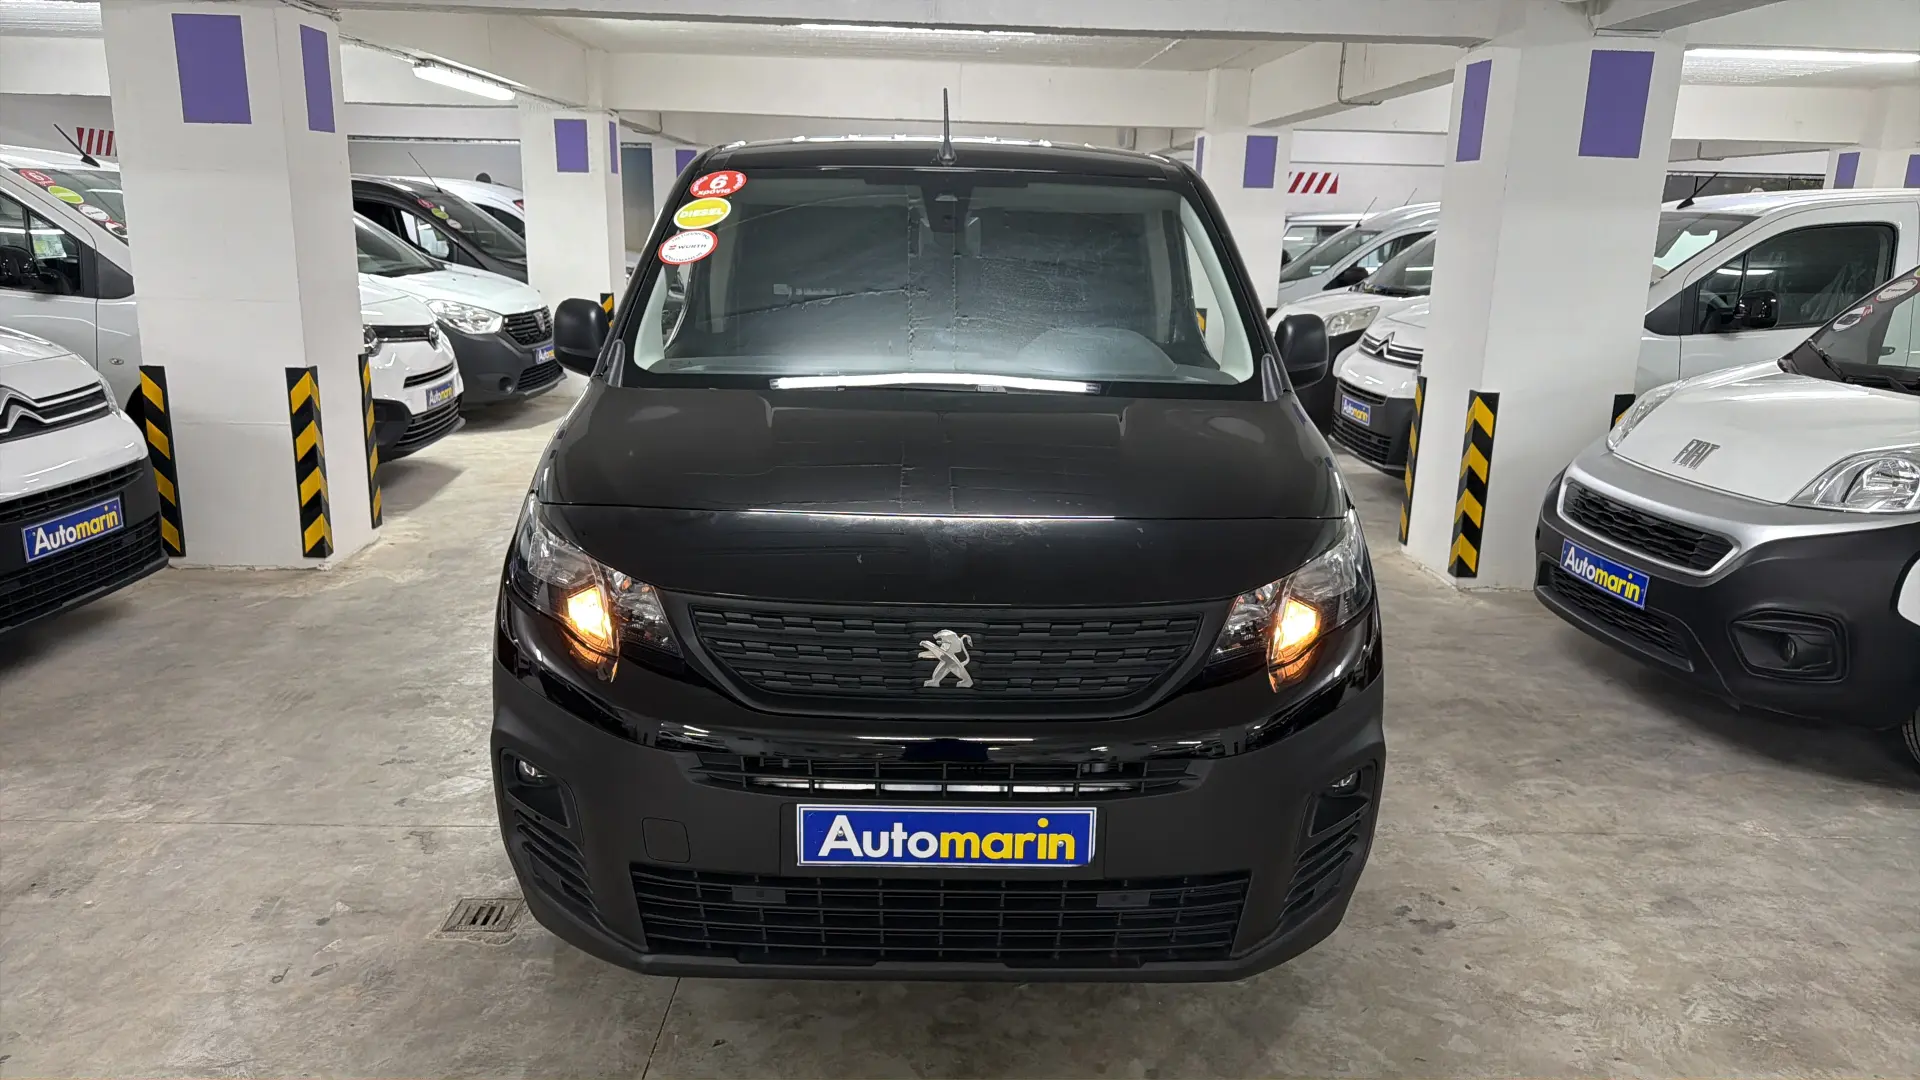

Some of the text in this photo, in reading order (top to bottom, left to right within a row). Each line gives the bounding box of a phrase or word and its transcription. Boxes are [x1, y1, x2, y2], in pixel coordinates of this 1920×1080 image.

[709, 174, 729, 190] 6
[679, 207, 724, 219] DIESEL
[1672, 438, 1721, 470] FIAT
[34, 505, 119, 555] Automarin
[1564, 546, 1641, 602] Automarin
[818, 814, 1075, 860] Automarin
